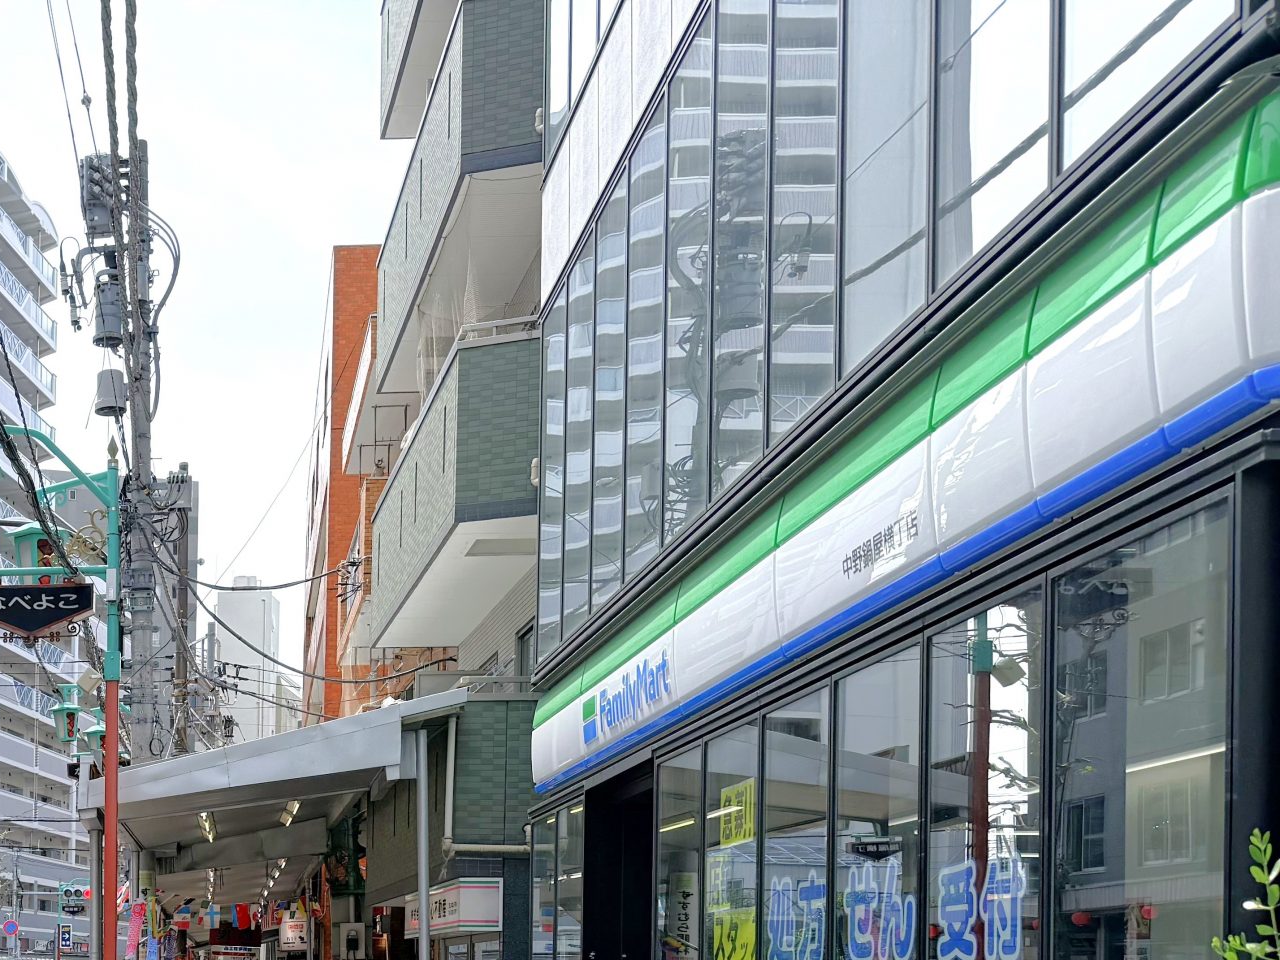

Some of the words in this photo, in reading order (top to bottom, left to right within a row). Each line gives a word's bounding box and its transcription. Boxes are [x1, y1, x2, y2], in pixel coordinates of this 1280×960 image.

[842, 510, 919, 580] 中野鍋屋横丁店
[600, 650, 671, 732] FamilyMart
